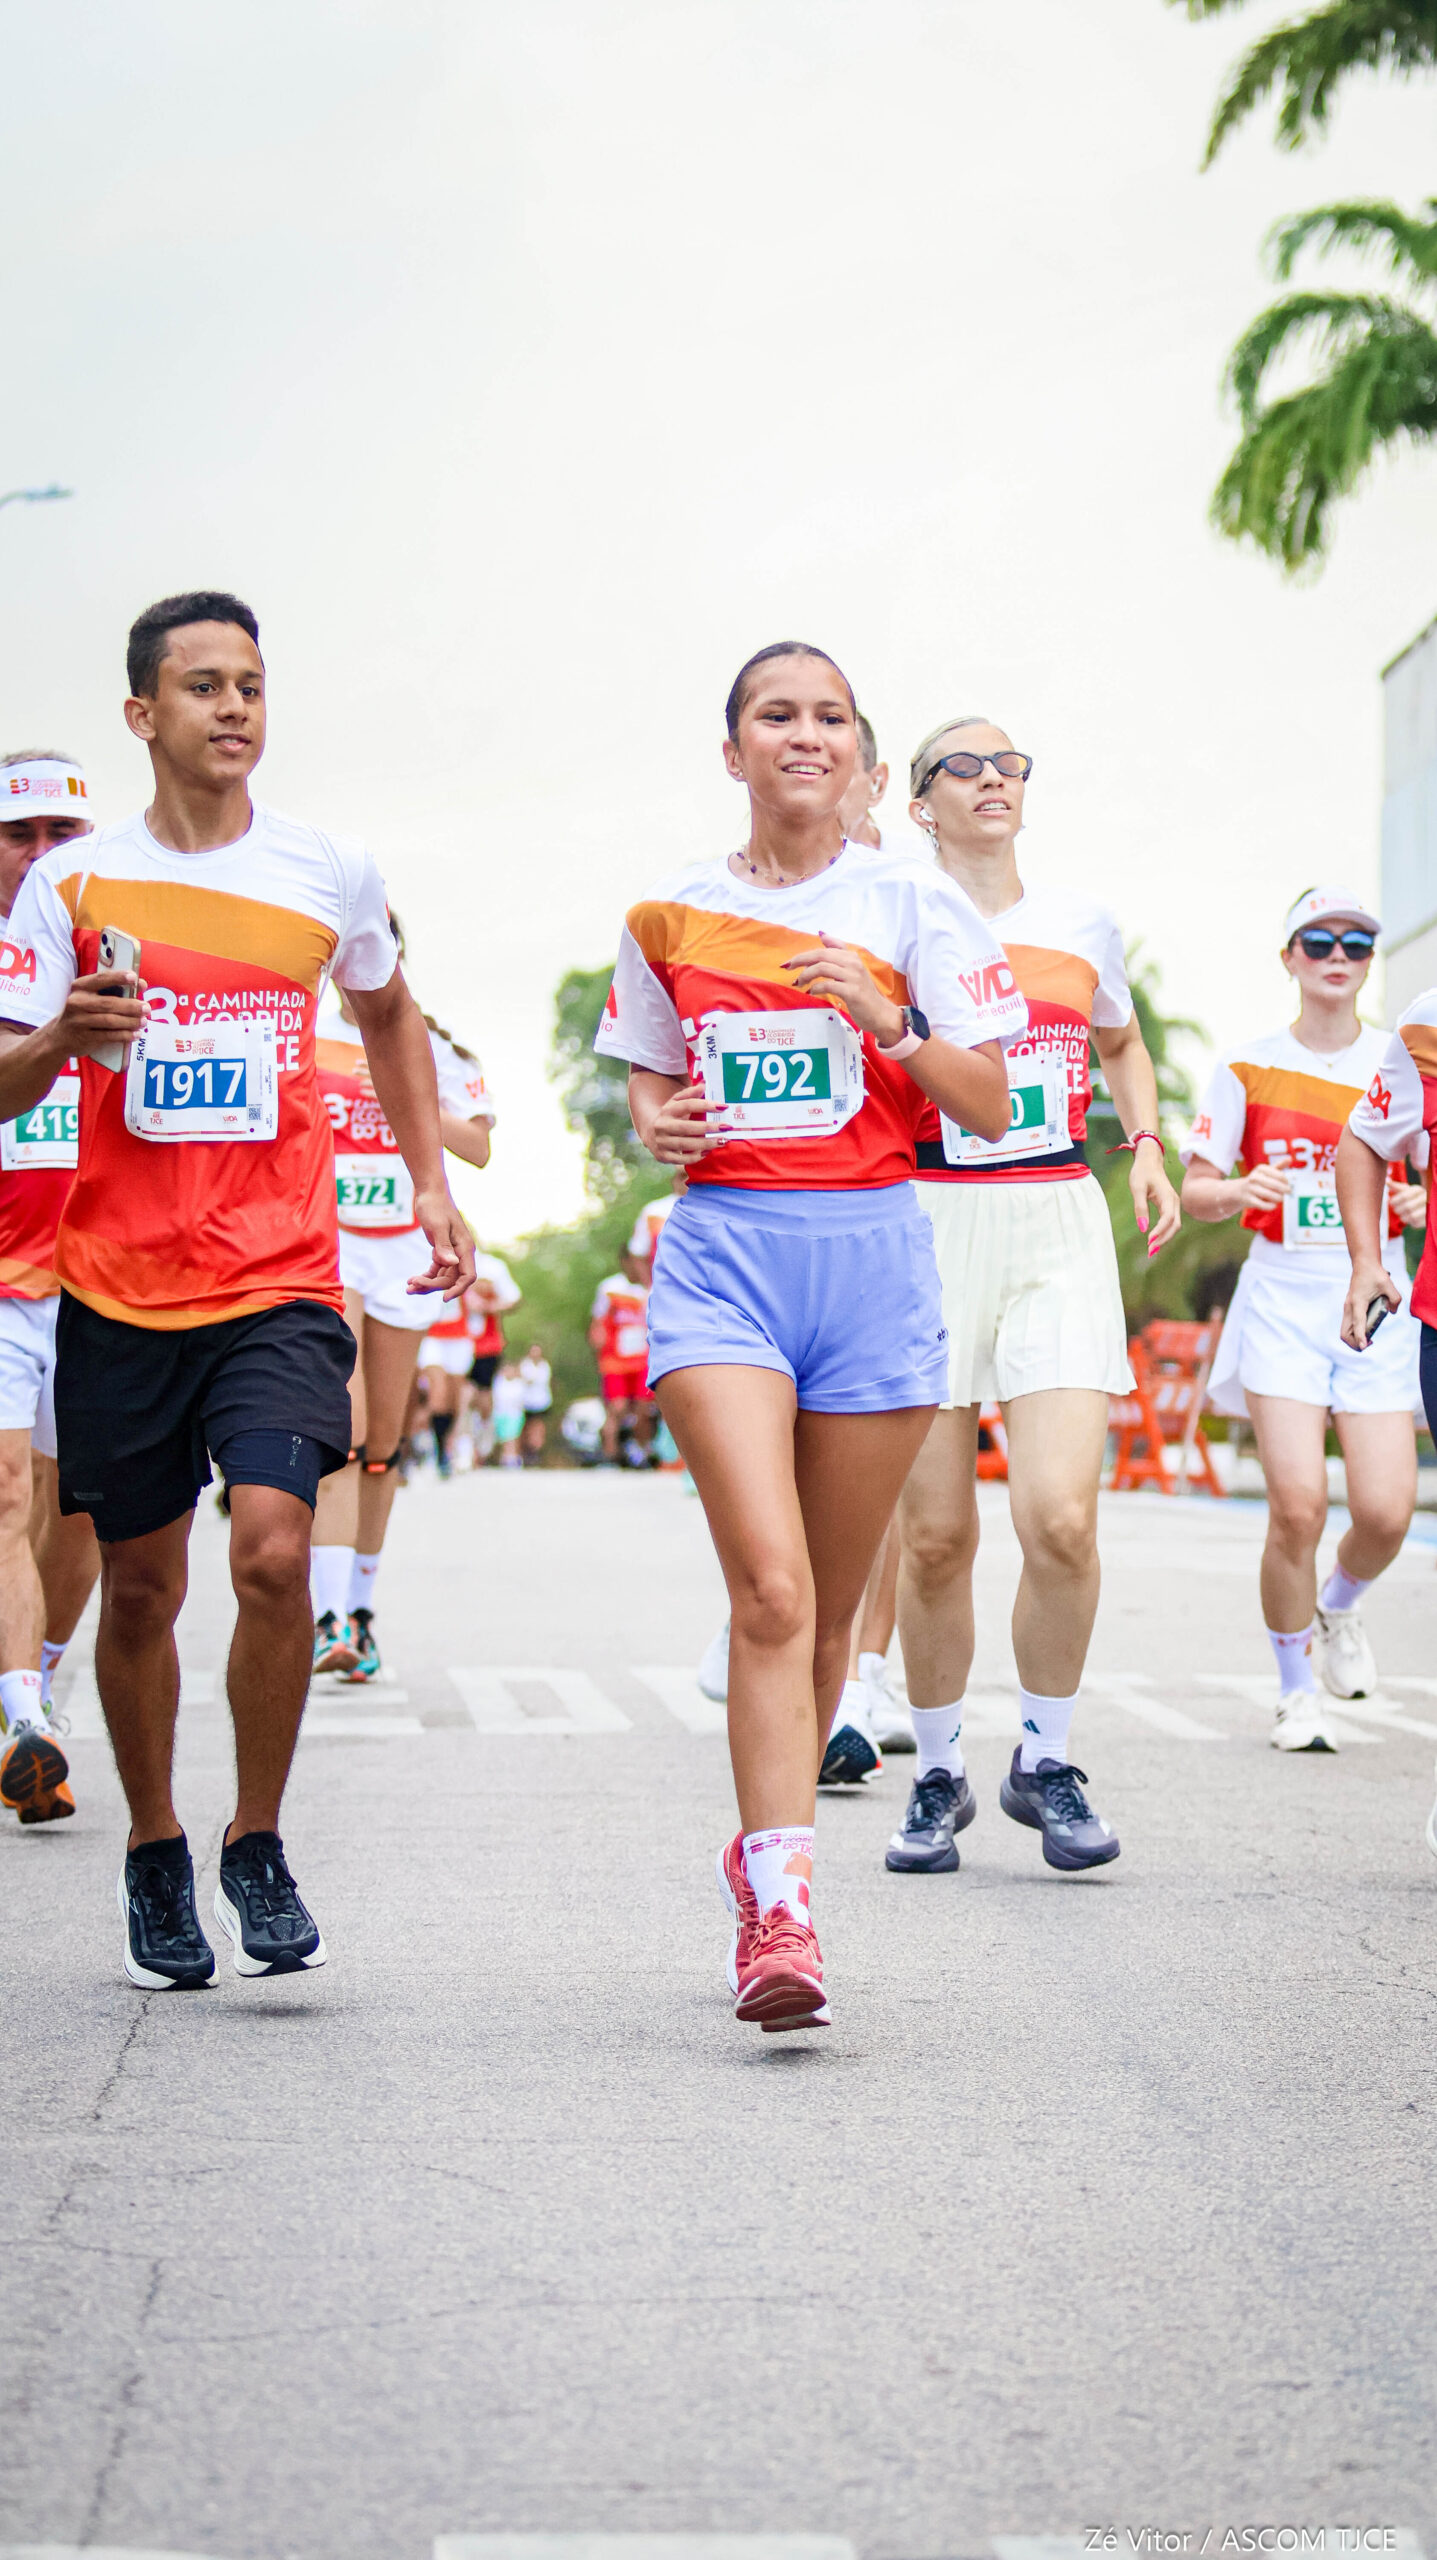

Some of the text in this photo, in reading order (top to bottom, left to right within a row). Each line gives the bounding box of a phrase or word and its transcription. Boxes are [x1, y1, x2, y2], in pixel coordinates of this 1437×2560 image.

[194, 991, 306, 1011] CAMINHADA
[136, 1038, 146, 1061] 5KM
[706, 1036, 718, 1060] 3KM
[149, 1062, 245, 1106] 1917
[736, 1053, 816, 1098] 792
[25, 1107, 79, 1140] 419
[341, 1178, 389, 1205] 372
[1307, 1198, 1342, 1227] 63
